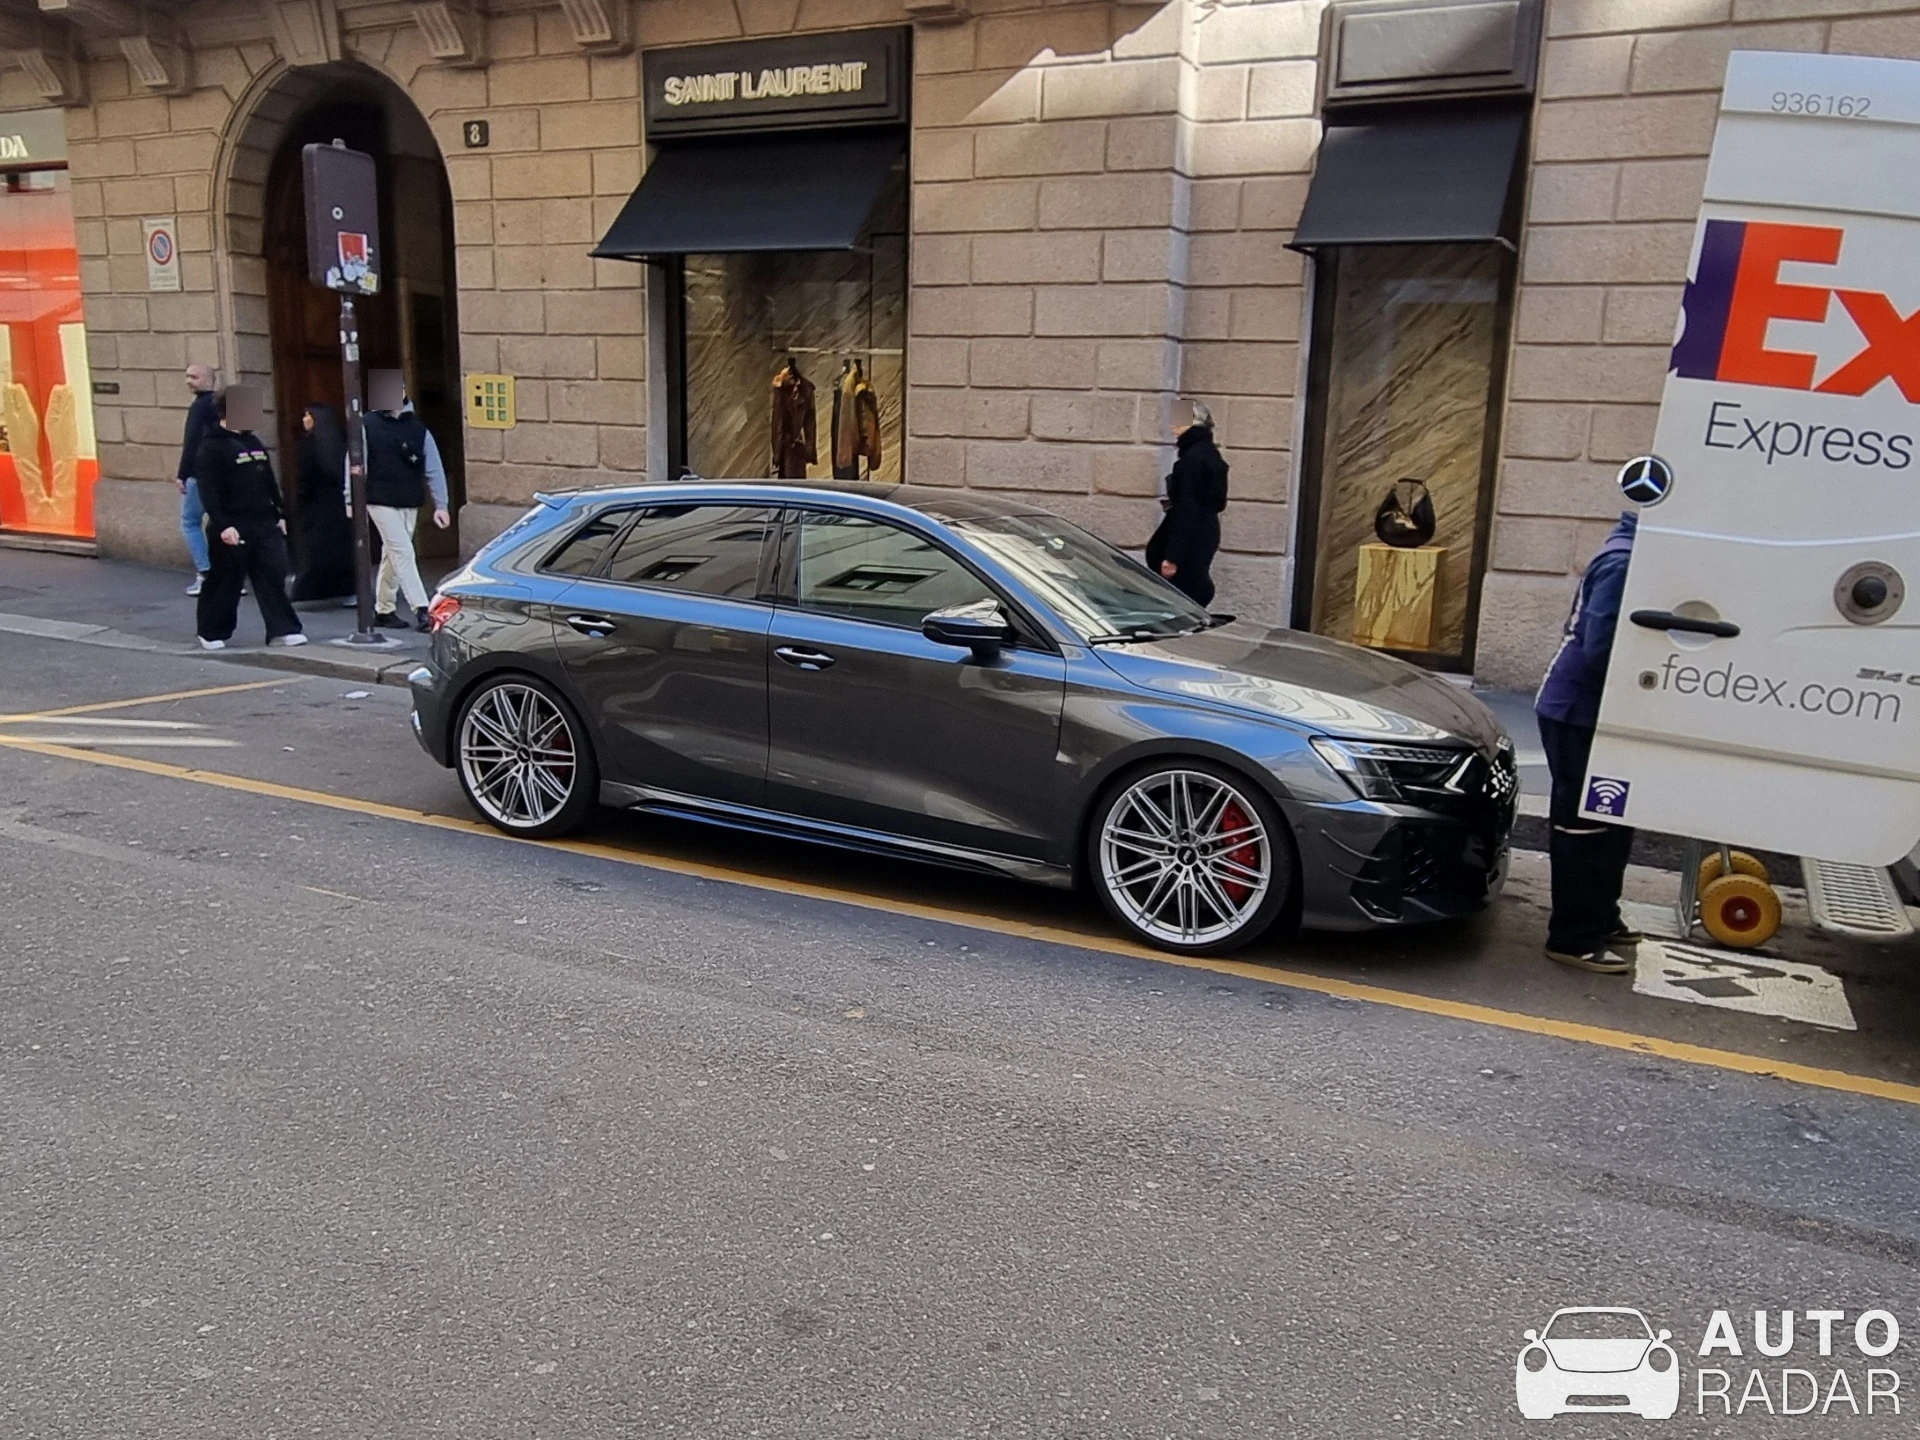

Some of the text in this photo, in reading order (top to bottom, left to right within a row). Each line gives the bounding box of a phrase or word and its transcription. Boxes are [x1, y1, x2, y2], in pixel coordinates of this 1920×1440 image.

[664, 62, 867, 106] SAINT LAURENT
[1771, 91, 1871, 118] 936162
[470, 123, 480, 144] 8
[1705, 401, 1913, 470] Express
[1661, 653, 1901, 722] fedex.com
